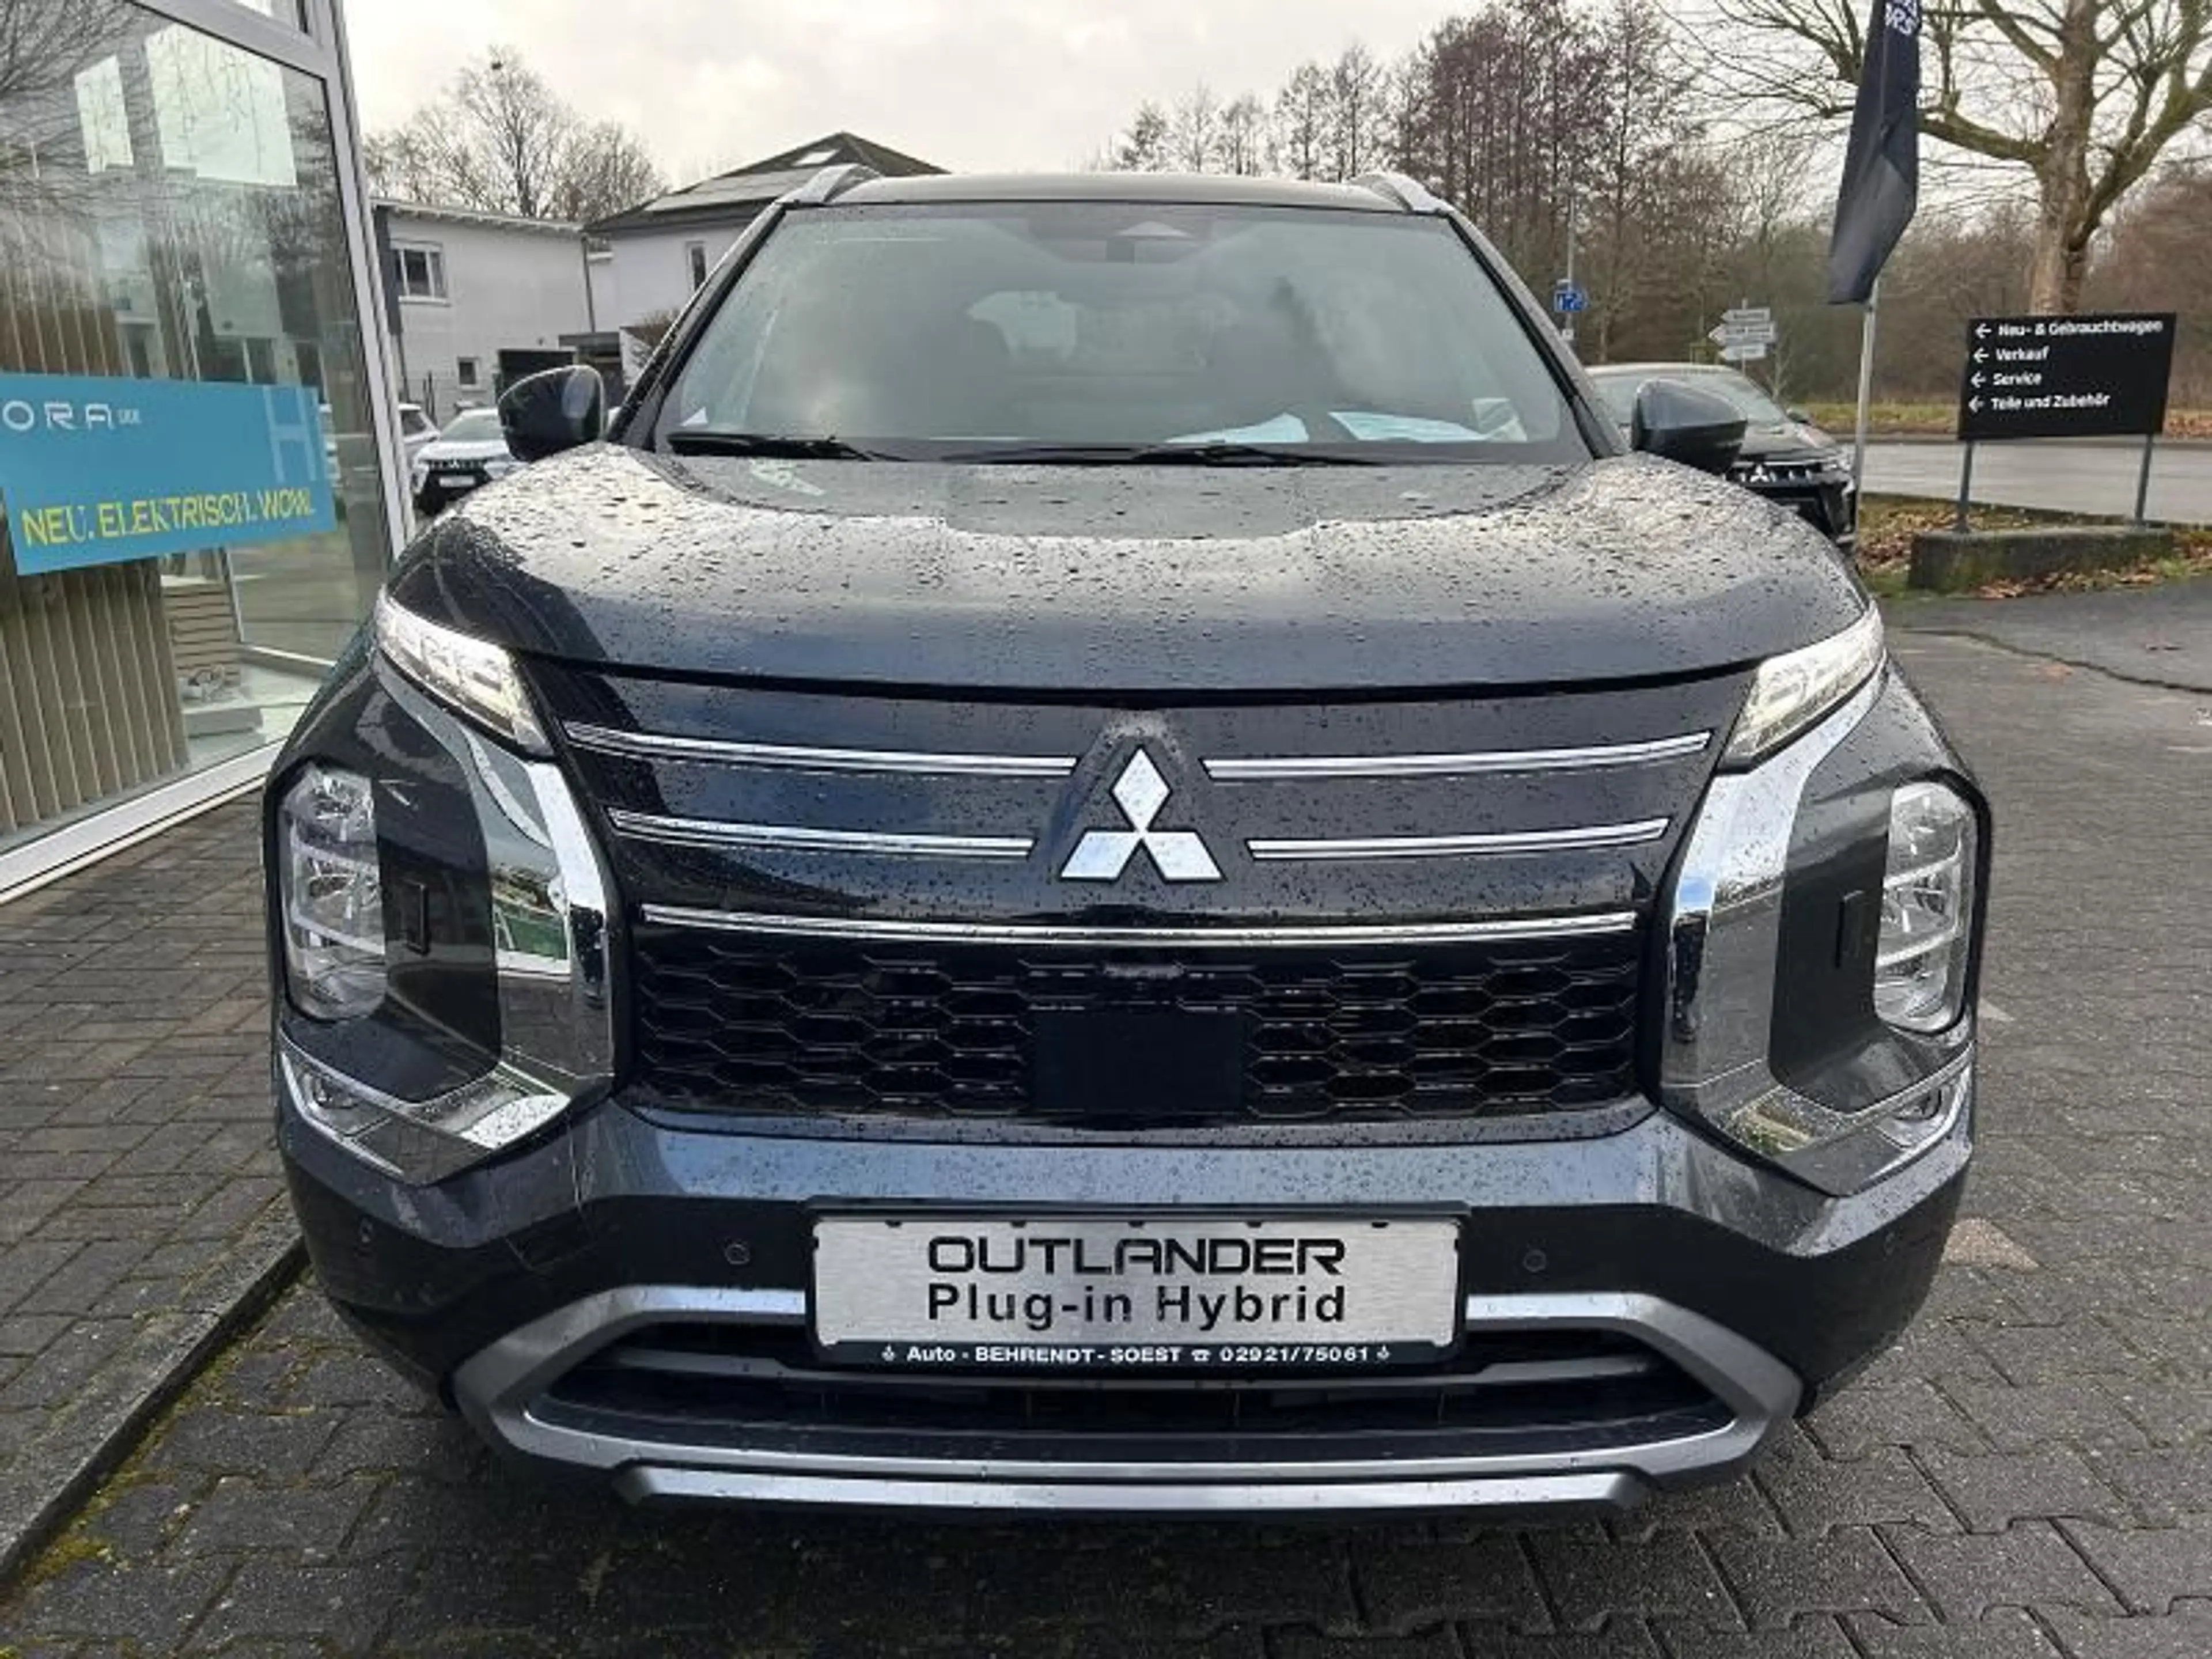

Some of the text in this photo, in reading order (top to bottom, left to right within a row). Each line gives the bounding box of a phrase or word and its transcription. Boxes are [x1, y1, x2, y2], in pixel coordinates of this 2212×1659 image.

[1998, 323, 2032, 336] Neu-
[2048, 320, 2163, 336] Gebrauchtwagen
[1996, 346, 2050, 361] Verkauf
[1993, 372, 2042, 386] Service
[1991, 392, 2111, 411] Teile und Zubehör
[2, 400, 113, 431] ORA
[928, 1236, 1346, 1275] OUTLANDER
[928, 1282, 1345, 1332] Plug-in Hybrid
[906, 1347, 956, 1362] Auto
[976, 1347, 1094, 1363] BEHRENDT
[1109, 1347, 1183, 1363] SOEST
[1219, 1346, 1369, 1362] 02921/75061
